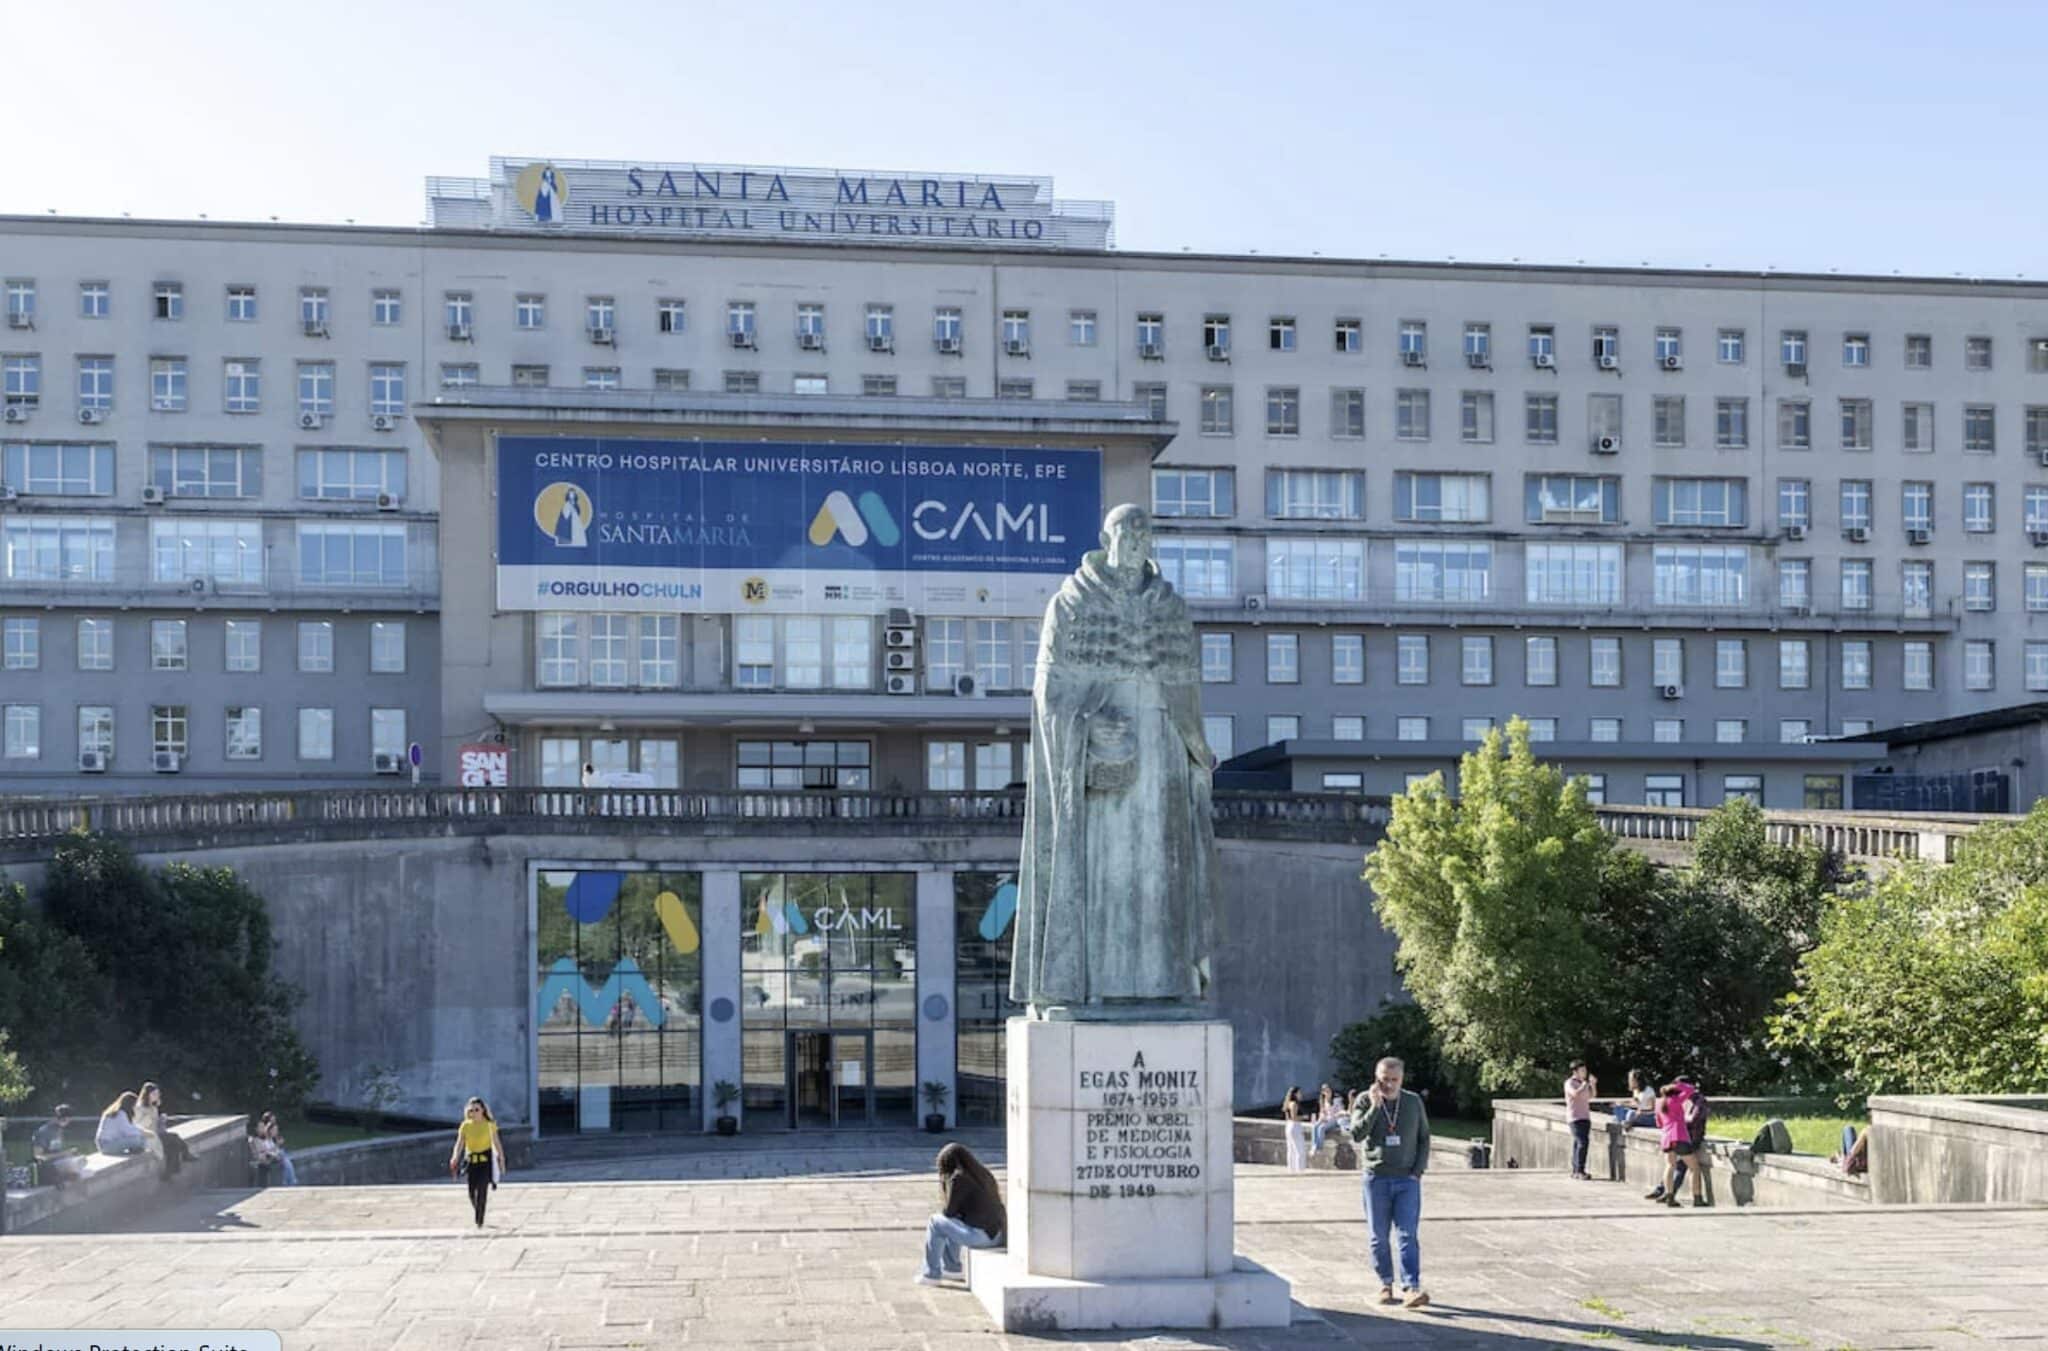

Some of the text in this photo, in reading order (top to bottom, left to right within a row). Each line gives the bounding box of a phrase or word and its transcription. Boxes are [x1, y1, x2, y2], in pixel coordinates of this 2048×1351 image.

[627, 167, 1006, 212] SANTA MARIA
[590, 204, 1043, 240] HOSPITAL UNIVERSITÁRIO
[535, 453, 1067, 480] CENTRO HOSPITALAR UNIVERSITÁRIO LISBOA NORTE, EPE
[599, 512, 750, 523] HOSPITAL DE
[912, 500, 1066, 544] CAML
[537, 580, 702, 599] #ORGULHOCHULN
[461, 751, 507, 770] SAN
[813, 906, 903, 931] CAML
[1132, 1050, 1145, 1069] A
[1080, 1070, 1199, 1089] EGAS MONIZ
[1145, 1113, 1194, 1127] NOBEL
[1086, 1129, 1193, 1143] DE MEDICINA
[1086, 1145, 1192, 1160] E FISIOLOGIA
[1088, 1184, 1156, 1199] DE 1949
